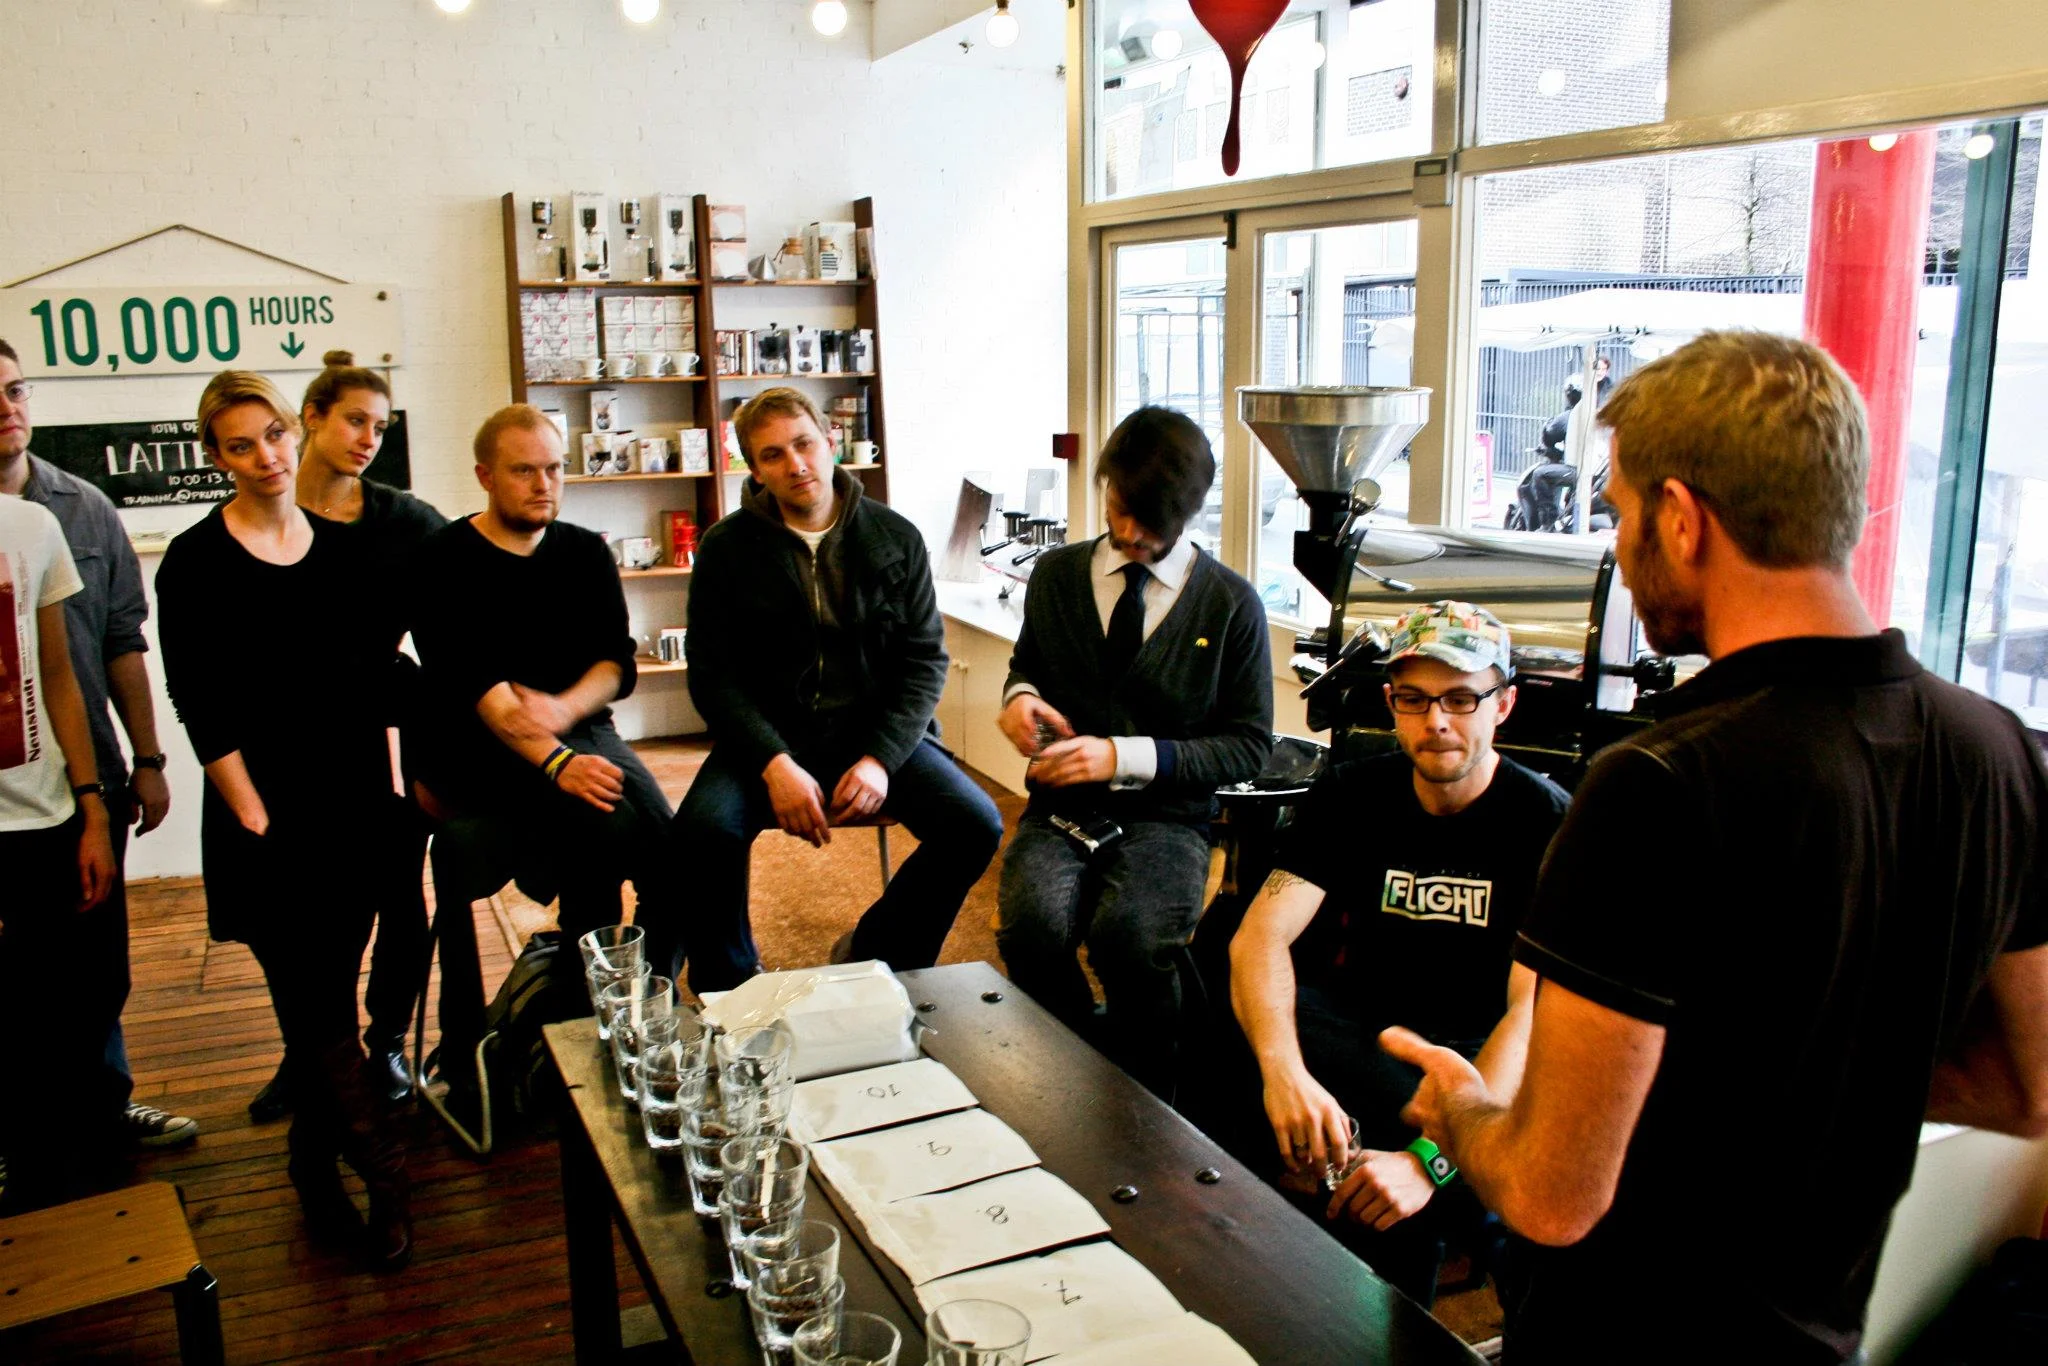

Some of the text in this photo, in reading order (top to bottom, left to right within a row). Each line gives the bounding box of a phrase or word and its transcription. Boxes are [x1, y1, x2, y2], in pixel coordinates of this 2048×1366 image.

[31, 296, 334, 372] 10,000 HOURS
[106, 441, 213, 475] LATTE
[1386, 875, 1490, 922] FLIGHT
